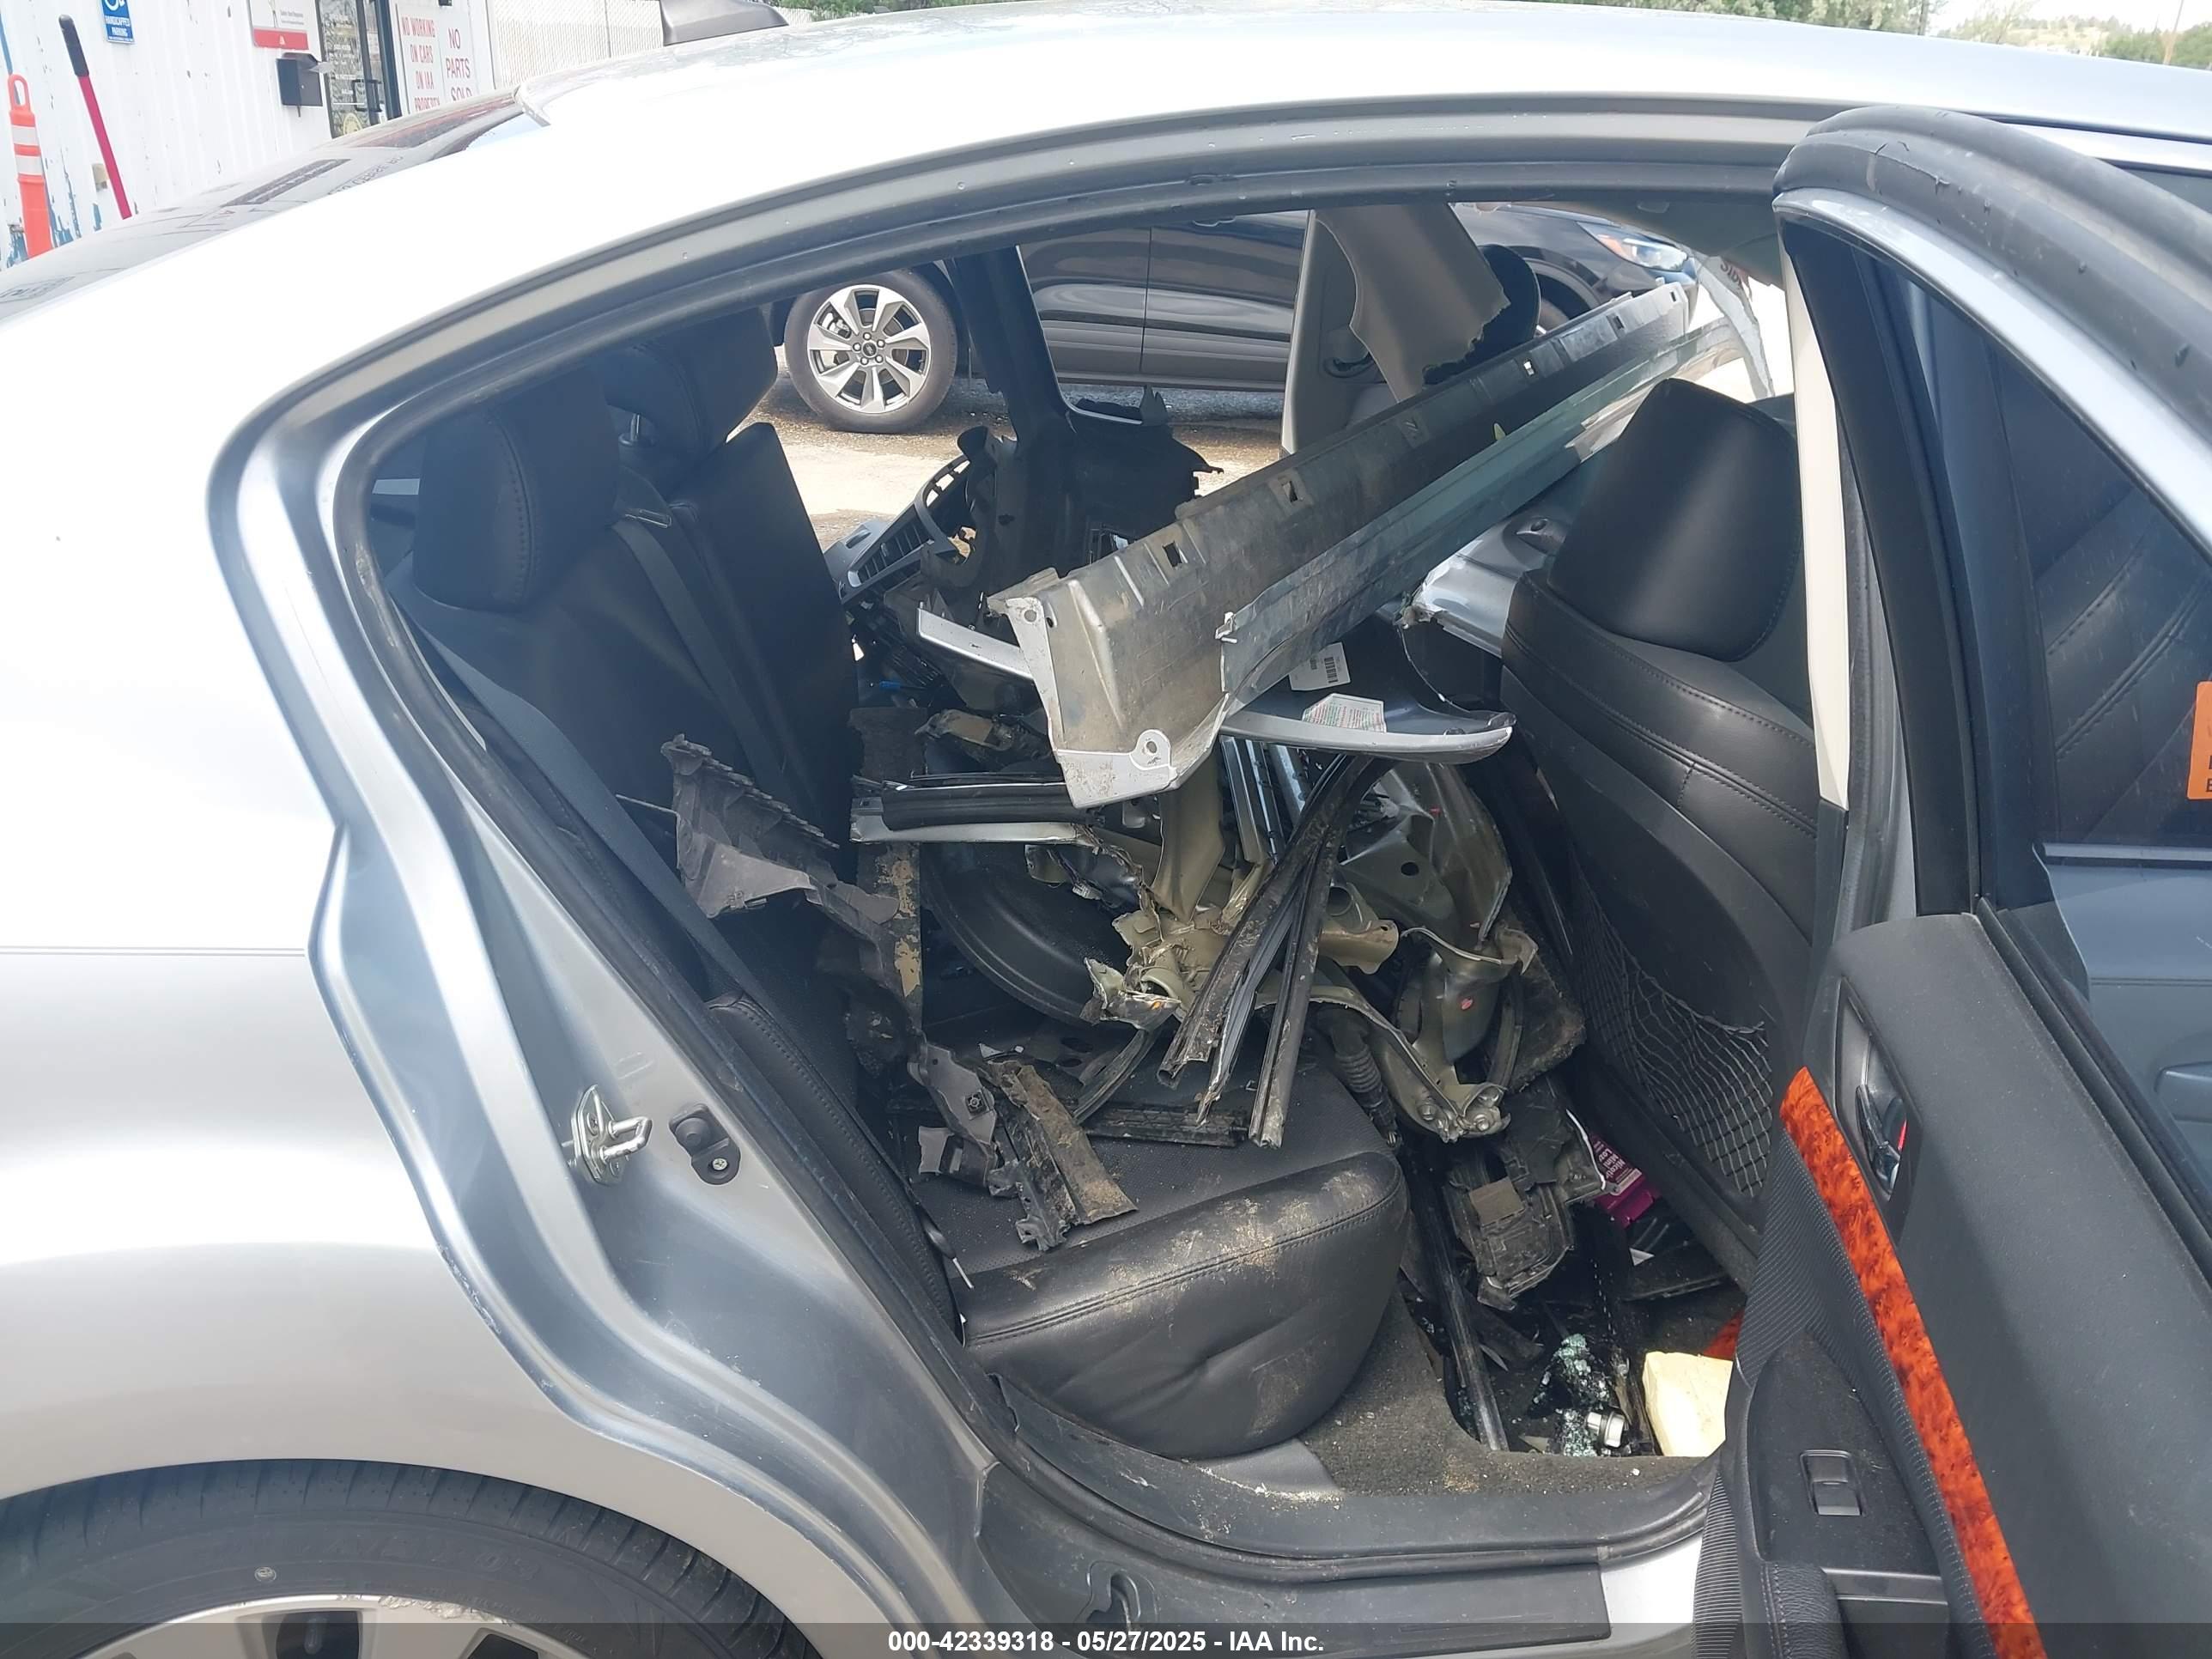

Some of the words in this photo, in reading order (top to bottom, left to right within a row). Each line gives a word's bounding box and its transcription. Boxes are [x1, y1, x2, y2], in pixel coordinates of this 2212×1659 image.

[402, 16, 410, 36] NO
[410, 18, 435, 38] WORKING
[448, 27, 461, 50] NO
[410, 44, 418, 63] ON
[419, 45, 433, 64] CARS
[446, 57, 471, 79] PARTS
[416, 70, 424, 90] ON
[425, 70, 434, 90] IAA
[1606, 1158, 1626, 1179] Nicoti
